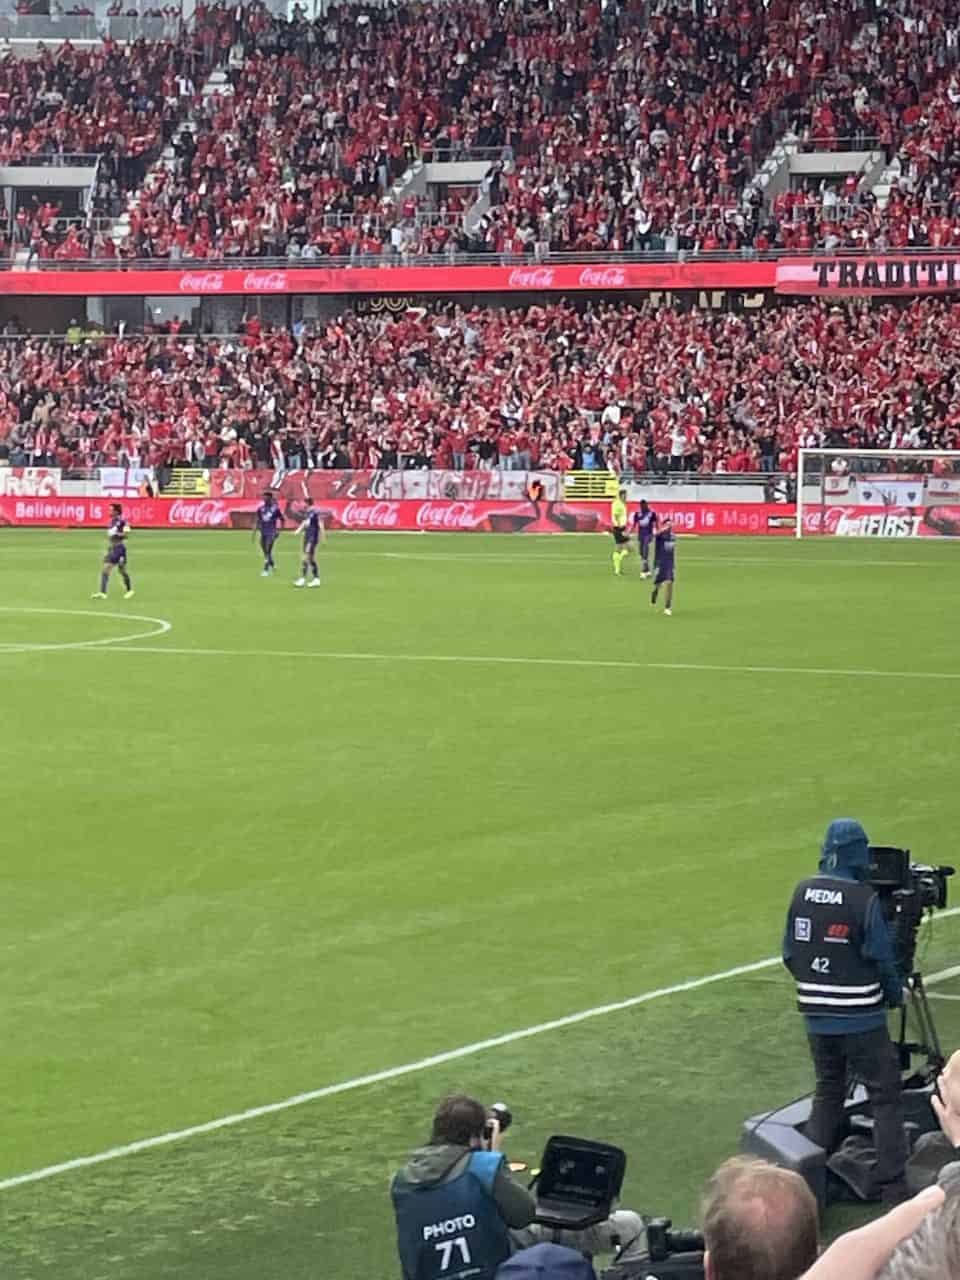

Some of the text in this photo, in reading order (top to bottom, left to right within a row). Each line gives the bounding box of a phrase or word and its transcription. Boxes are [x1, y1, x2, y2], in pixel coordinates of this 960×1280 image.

[16, 502, 85, 523] Believing
[90, 504, 102, 518] is
[701, 509, 715, 525] is
[804, 888, 843, 905] MEDIA
[811, 957, 830, 974] 42
[423, 1214, 476, 1241] PHOTO
[435, 1236, 471, 1271] 71
